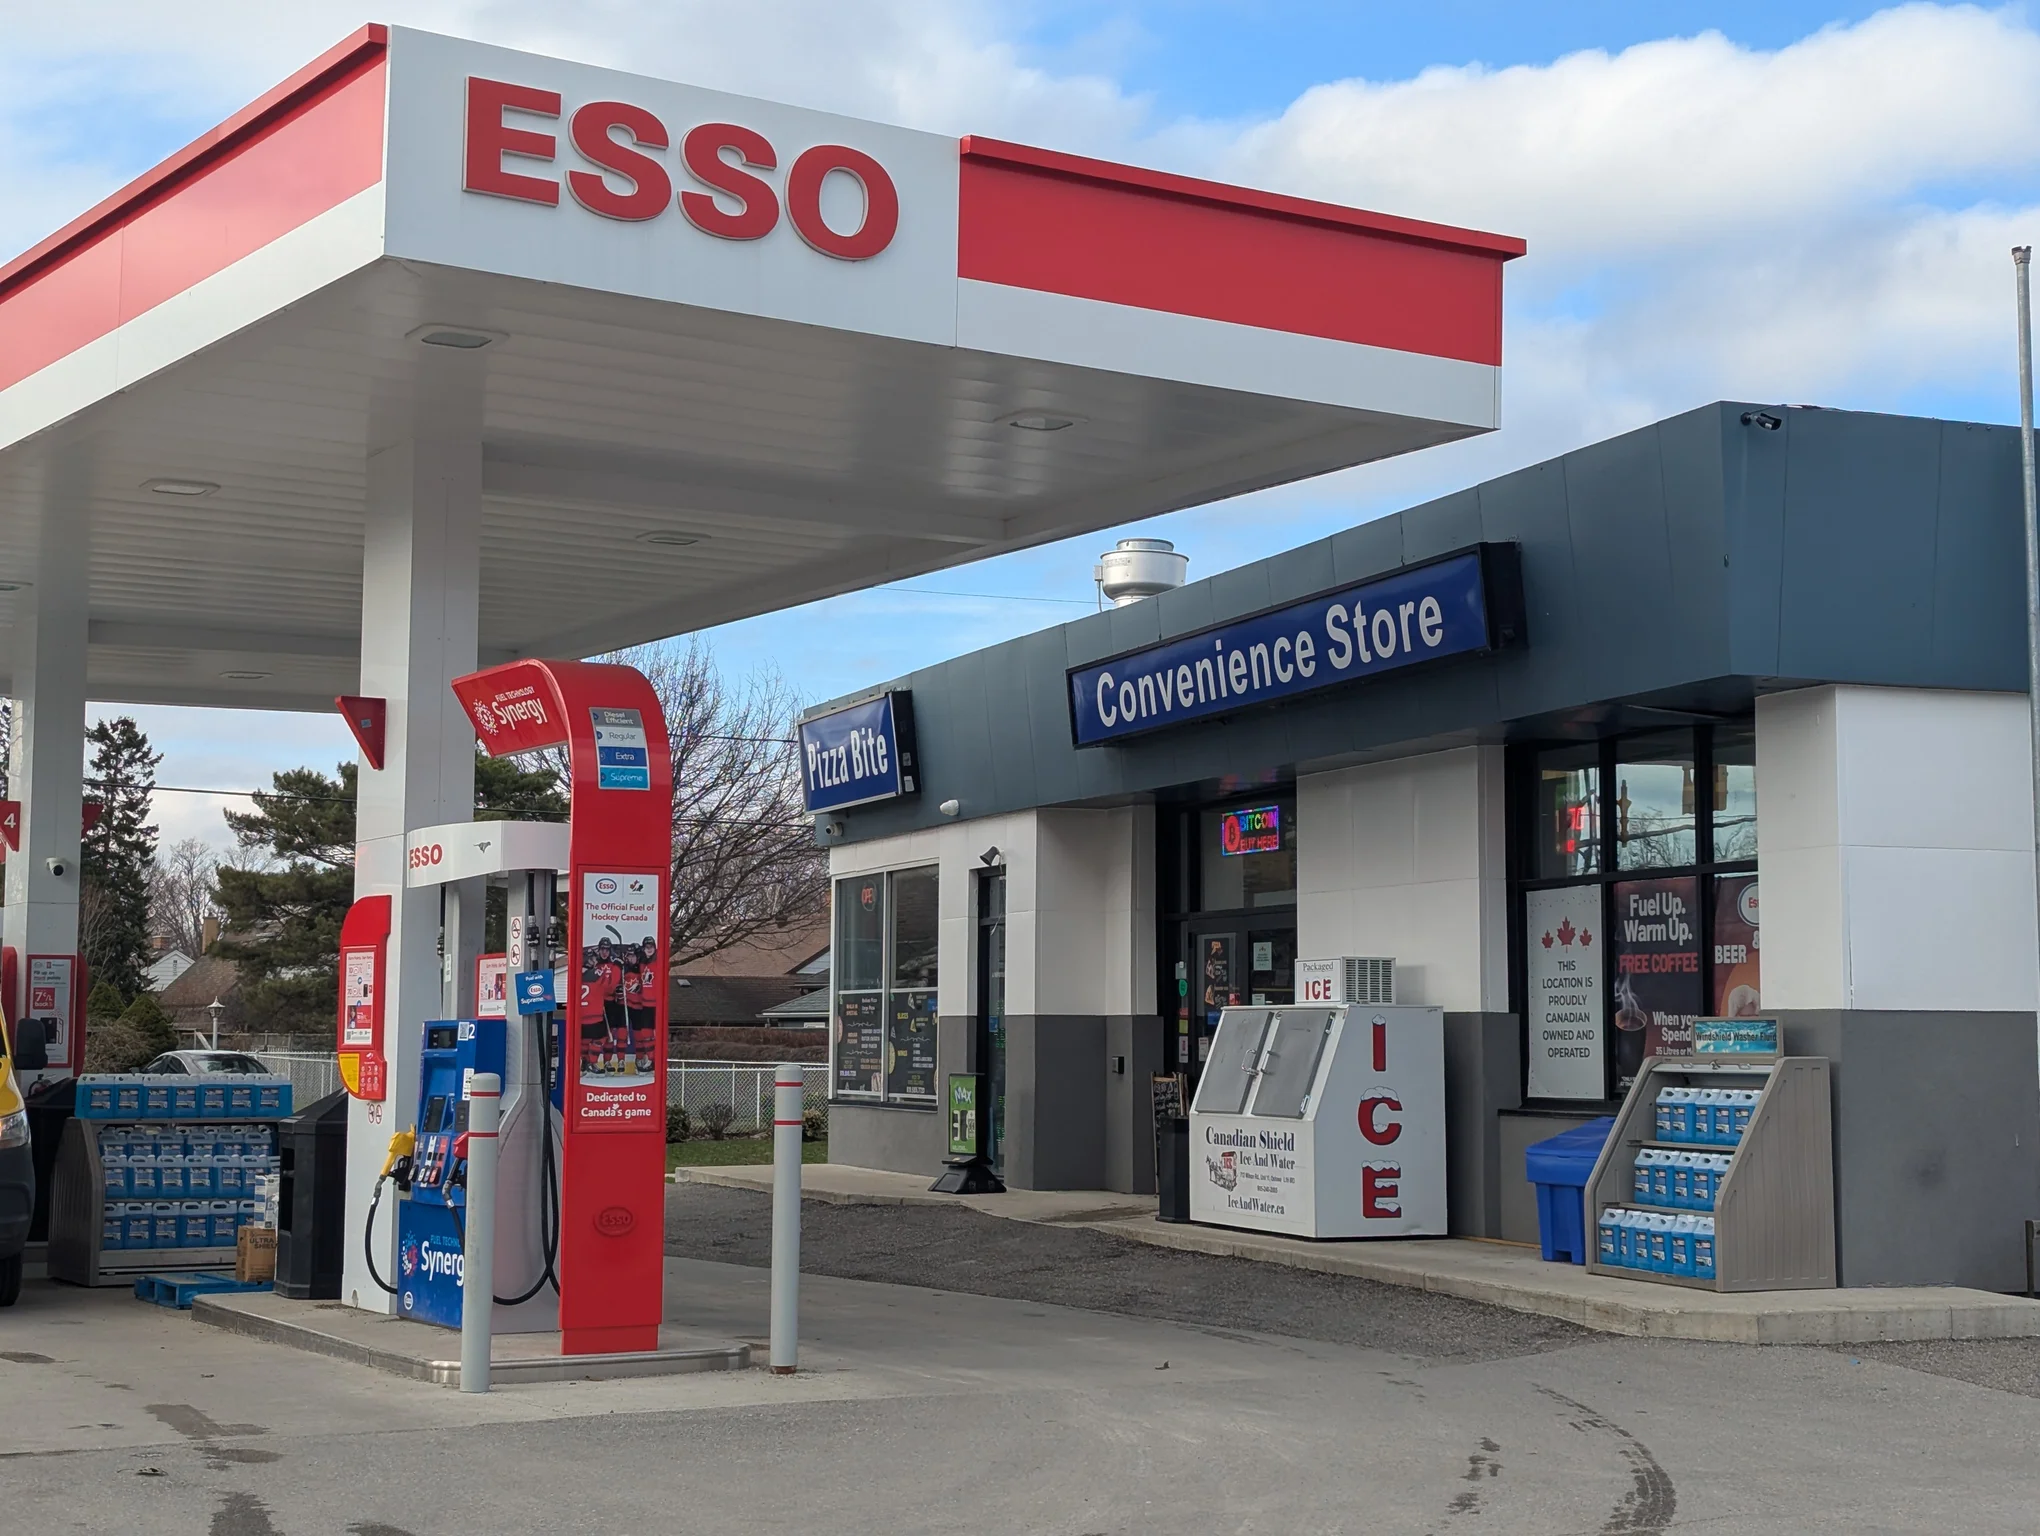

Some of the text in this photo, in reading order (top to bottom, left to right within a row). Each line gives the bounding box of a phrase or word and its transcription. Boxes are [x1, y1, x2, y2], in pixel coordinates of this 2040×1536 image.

[462, 75, 899, 262] ESSO
[1096, 596, 1443, 728] Convenience Store
[492, 698, 548, 730] Synergy
[605, 717, 634, 725] Efficient
[609, 732, 636, 742] Regular
[615, 752, 634, 761] Extra
[807, 727, 888, 791] Pizza Bite
[610, 773, 643, 784] Supreme
[4, 813, 16, 828] 4
[1240, 811, 1277, 831] BITCOIN
[409, 844, 443, 869] ESSO
[601, 903, 627, 911] Official
[646, 904, 654, 912] of
[1629, 892, 1686, 920] Fuel Up.
[591, 913, 619, 922] Hockey
[1624, 918, 1693, 946] Warm Up.
[1715, 945, 1746, 964] BEER
[1303, 961, 1333, 972] Packaged
[1558, 961, 1576, 971] THIS
[1619, 952, 1698, 974] FREE COFFEE
[1305, 977, 1331, 1000] ICE
[1543, 976, 1593, 988] LOCATION IS
[1549, 995, 1587, 1006] PROUDLY
[1546, 1012, 1590, 1023] CANADIAN
[1653, 1011, 1680, 1026] When
[469, 1024, 475, 1039] 2
[1543, 1030, 1595, 1041] OWNED AND
[1661, 1028, 1691, 1044] Spend
[1696, 1032, 1777, 1041] Windshield Washer Fluid
[1547, 1047, 1590, 1058] OPERATED
[1663, 1047, 1680, 1055] Litres
[586, 1092, 646, 1102] Dedicated to
[954, 1086, 972, 1104] MAX
[581, 1106, 652, 1119] Canada's game
[1206, 1126, 1294, 1151] Canadian Shield
[1240, 1151, 1295, 1170] Ice And Water
[1228, 1194, 1285, 1215] IceAndWater.ca
[430, 1234, 441, 1245] FUEL
[421, 1240, 464, 1287] Synerg
